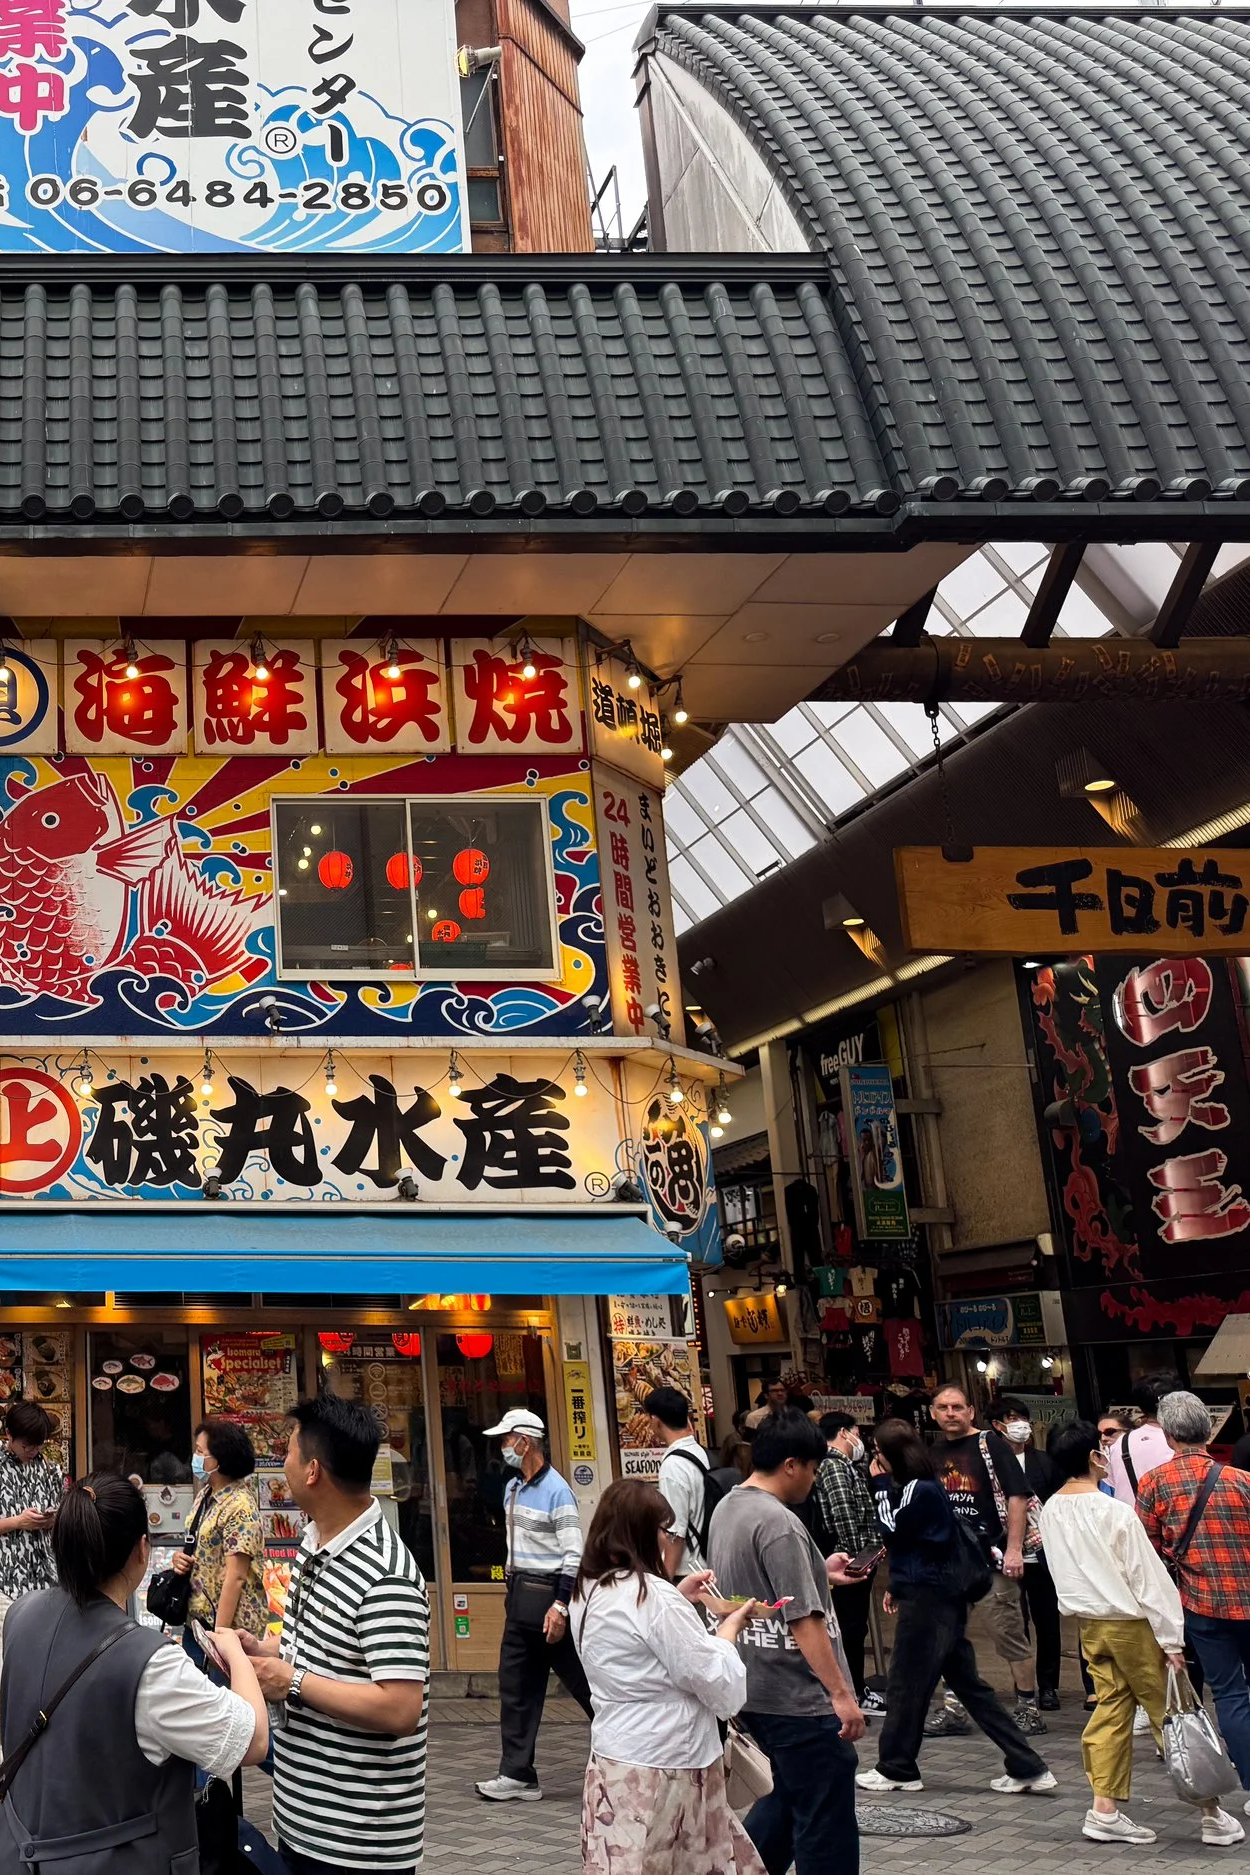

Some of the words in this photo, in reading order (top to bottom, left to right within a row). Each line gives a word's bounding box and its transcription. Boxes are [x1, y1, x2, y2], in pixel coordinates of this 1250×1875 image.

[29, 177, 448, 213] 06-6484-2850
[73, 648, 574, 747] 海鮮浜焼
[591, 676, 663, 754] 道頓堀
[603, 790, 644, 1035] 24時間営業中
[1006, 857, 1250, 938] 千日前
[85, 1071, 578, 1192] 磯丸水産
[570, 1387, 587, 1440] 一番搾り
[269, 1549, 285, 1558] Red
